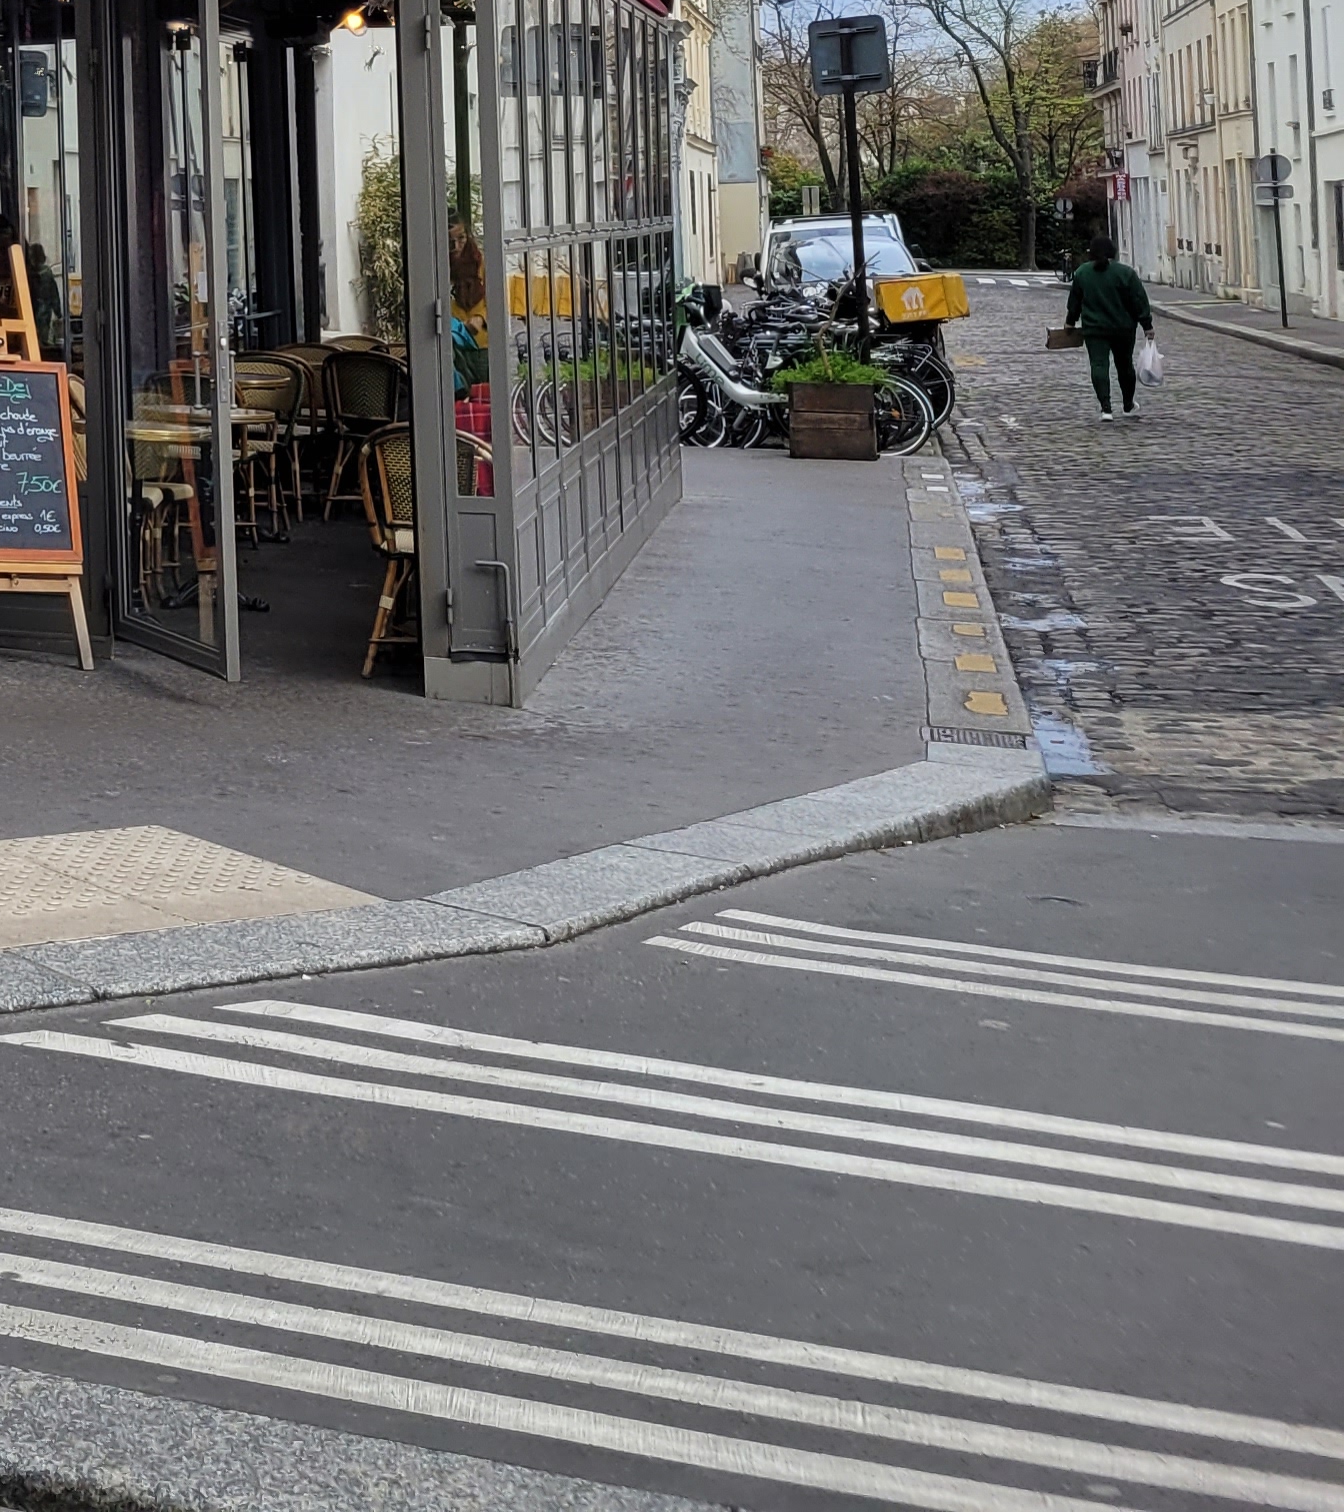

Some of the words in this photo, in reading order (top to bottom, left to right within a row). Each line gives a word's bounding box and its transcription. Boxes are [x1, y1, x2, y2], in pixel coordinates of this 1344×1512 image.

[16, 471, 63, 496] 7,50€
[39, 508, 56, 522] 1€
[33, 523, 62, 535] 0,50€
